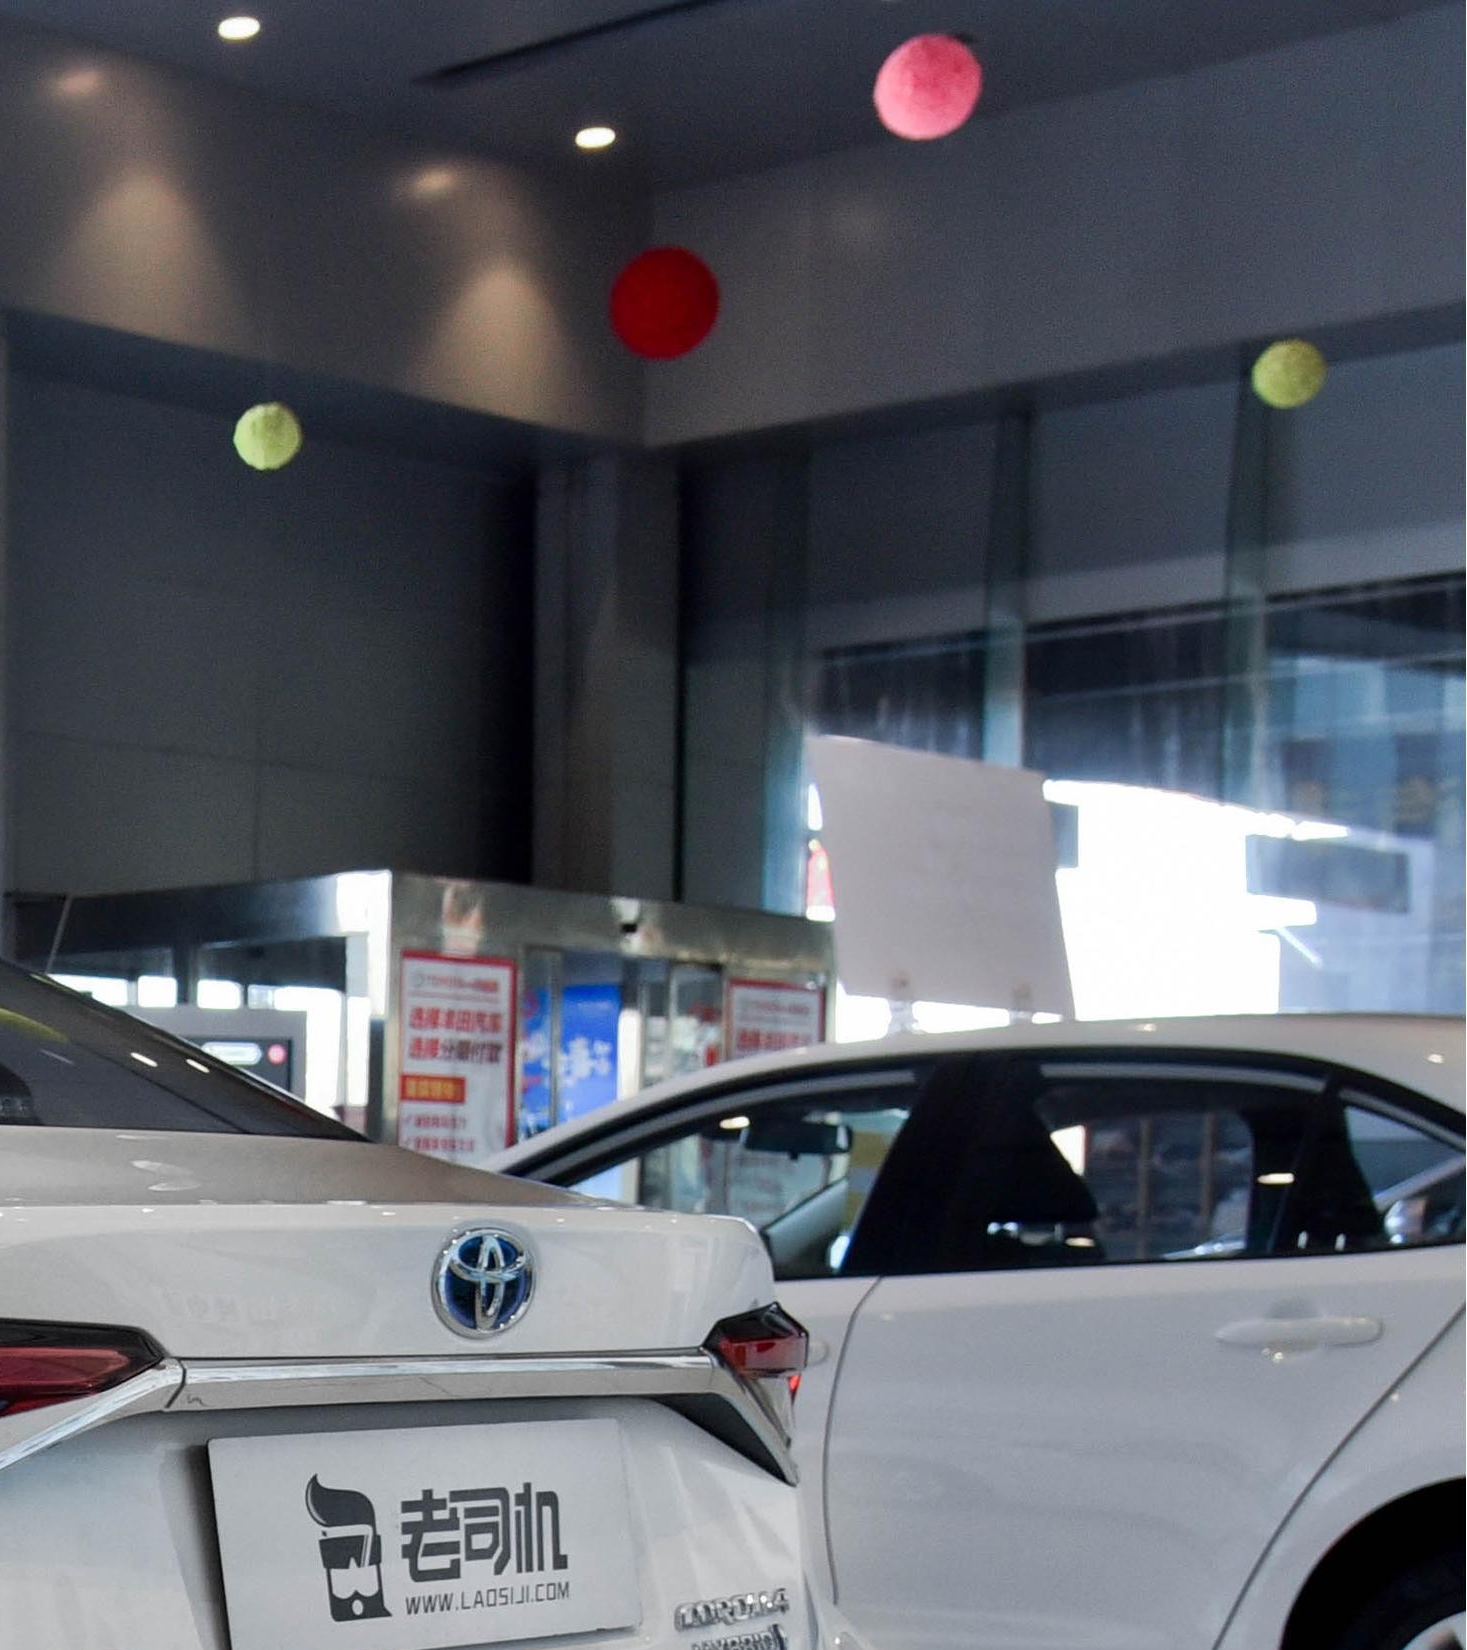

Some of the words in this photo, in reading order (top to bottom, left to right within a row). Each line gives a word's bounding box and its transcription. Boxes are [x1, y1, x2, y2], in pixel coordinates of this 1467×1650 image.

[400, 1482, 568, 1582] 老司机
[405, 1581, 570, 1615] WWW.LAOSIJI.COM
